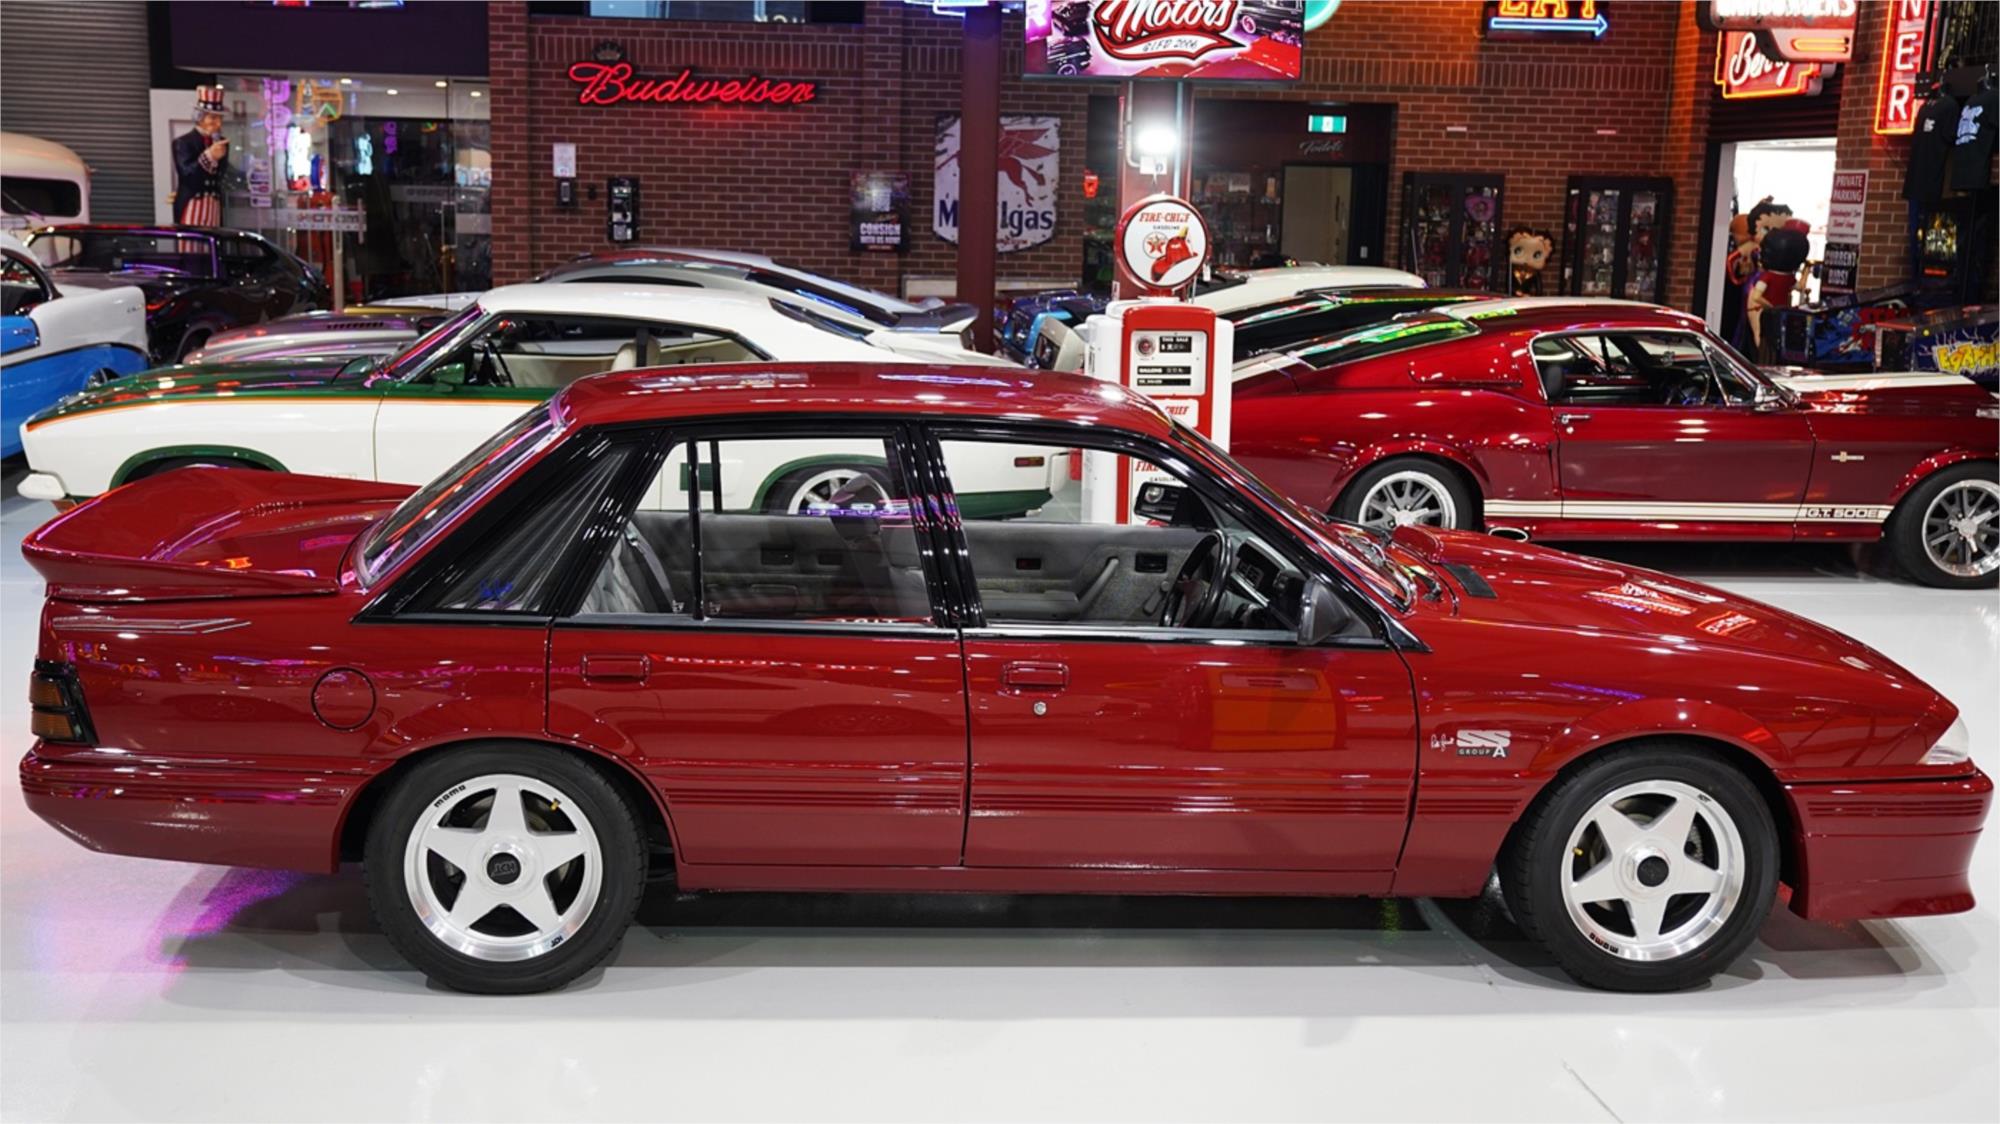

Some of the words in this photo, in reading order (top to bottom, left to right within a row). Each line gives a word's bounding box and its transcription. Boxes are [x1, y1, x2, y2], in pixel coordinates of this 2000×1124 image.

[568, 62, 815, 104] Budweiser
[1835, 175, 1864, 188] PRIVATE
[1833, 188, 1862, 202] PARKING
[938, 199, 1054, 237] Mlgas
[860, 223, 901, 235] CONSIGN
[1824, 250, 1857, 267] CURRENT
[1458, 748, 1491, 756] GROUP
[1492, 744, 1507, 758] A
